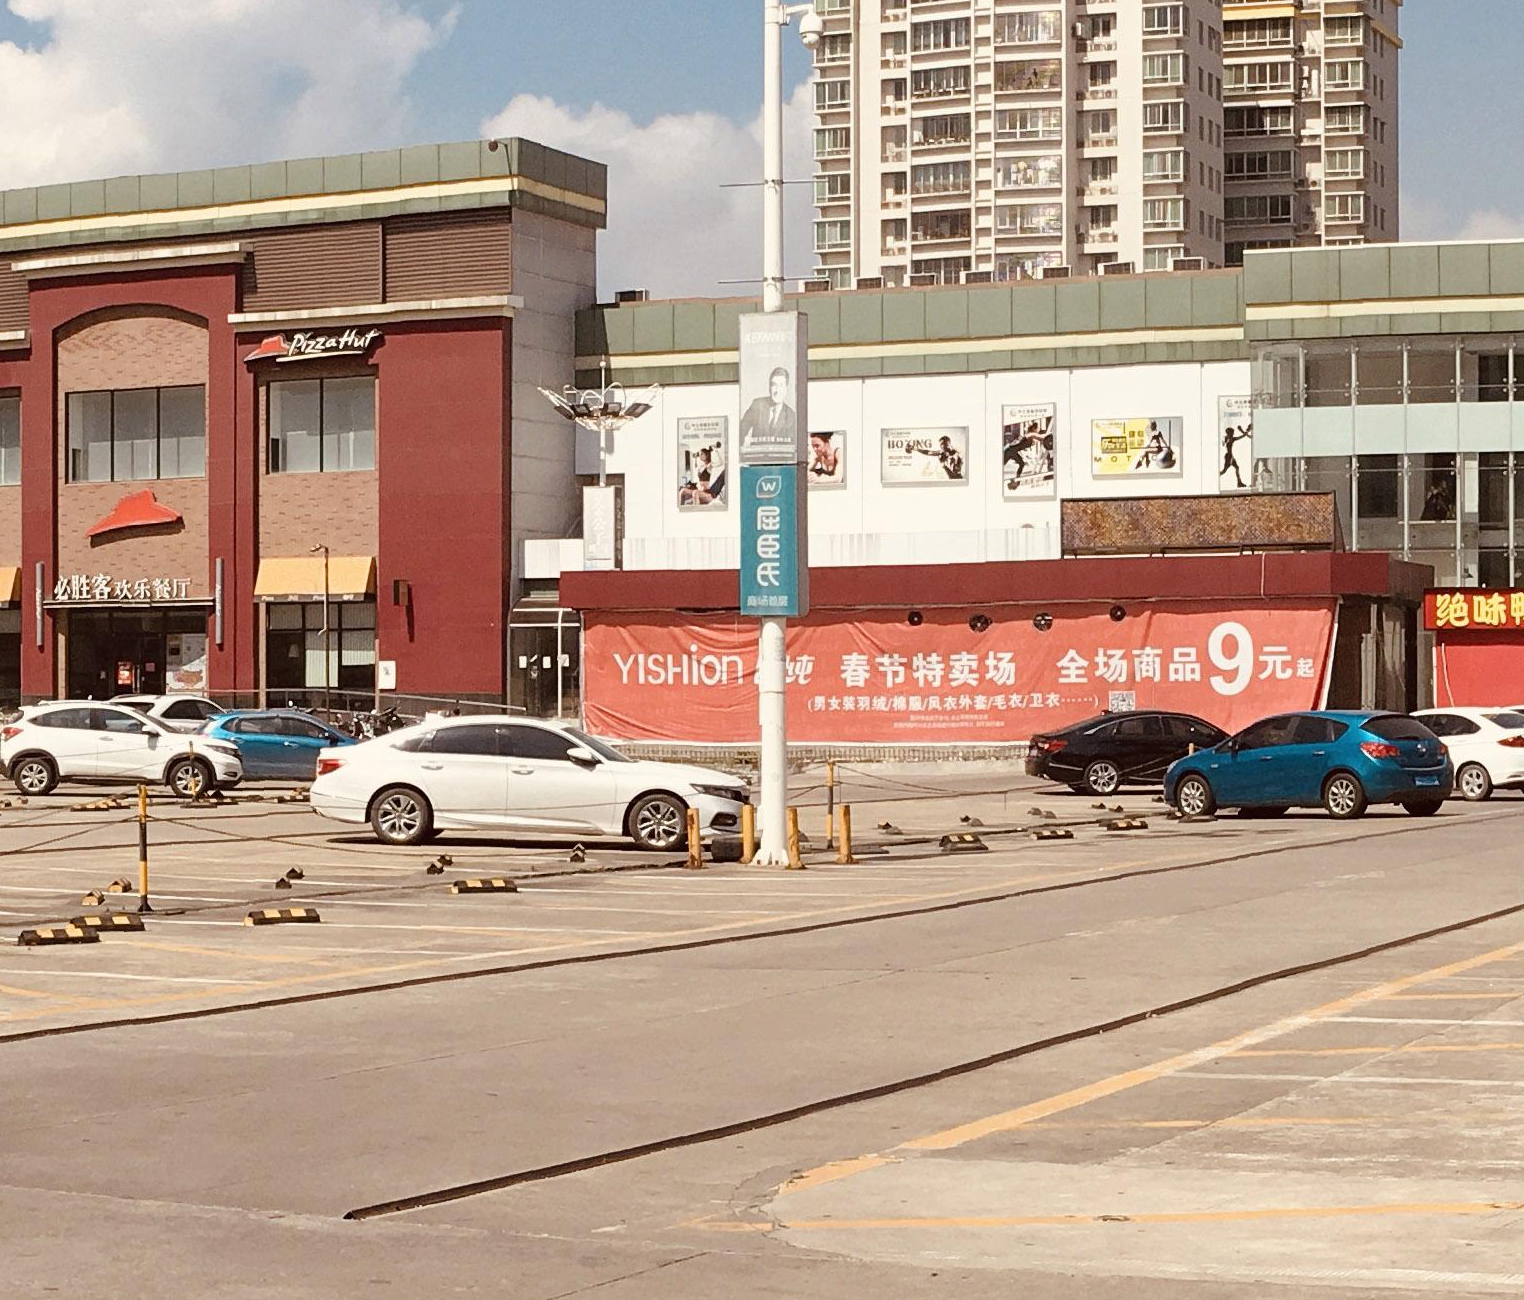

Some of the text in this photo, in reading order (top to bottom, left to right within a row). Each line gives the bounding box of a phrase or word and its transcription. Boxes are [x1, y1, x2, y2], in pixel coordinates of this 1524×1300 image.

[288, 328, 382, 356] Pizza Hut
[53, 573, 191, 601] 必胜客欢乐餐厅
[613, 643, 745, 686] YISHion
[840, 650, 1017, 687] 春节特卖场
